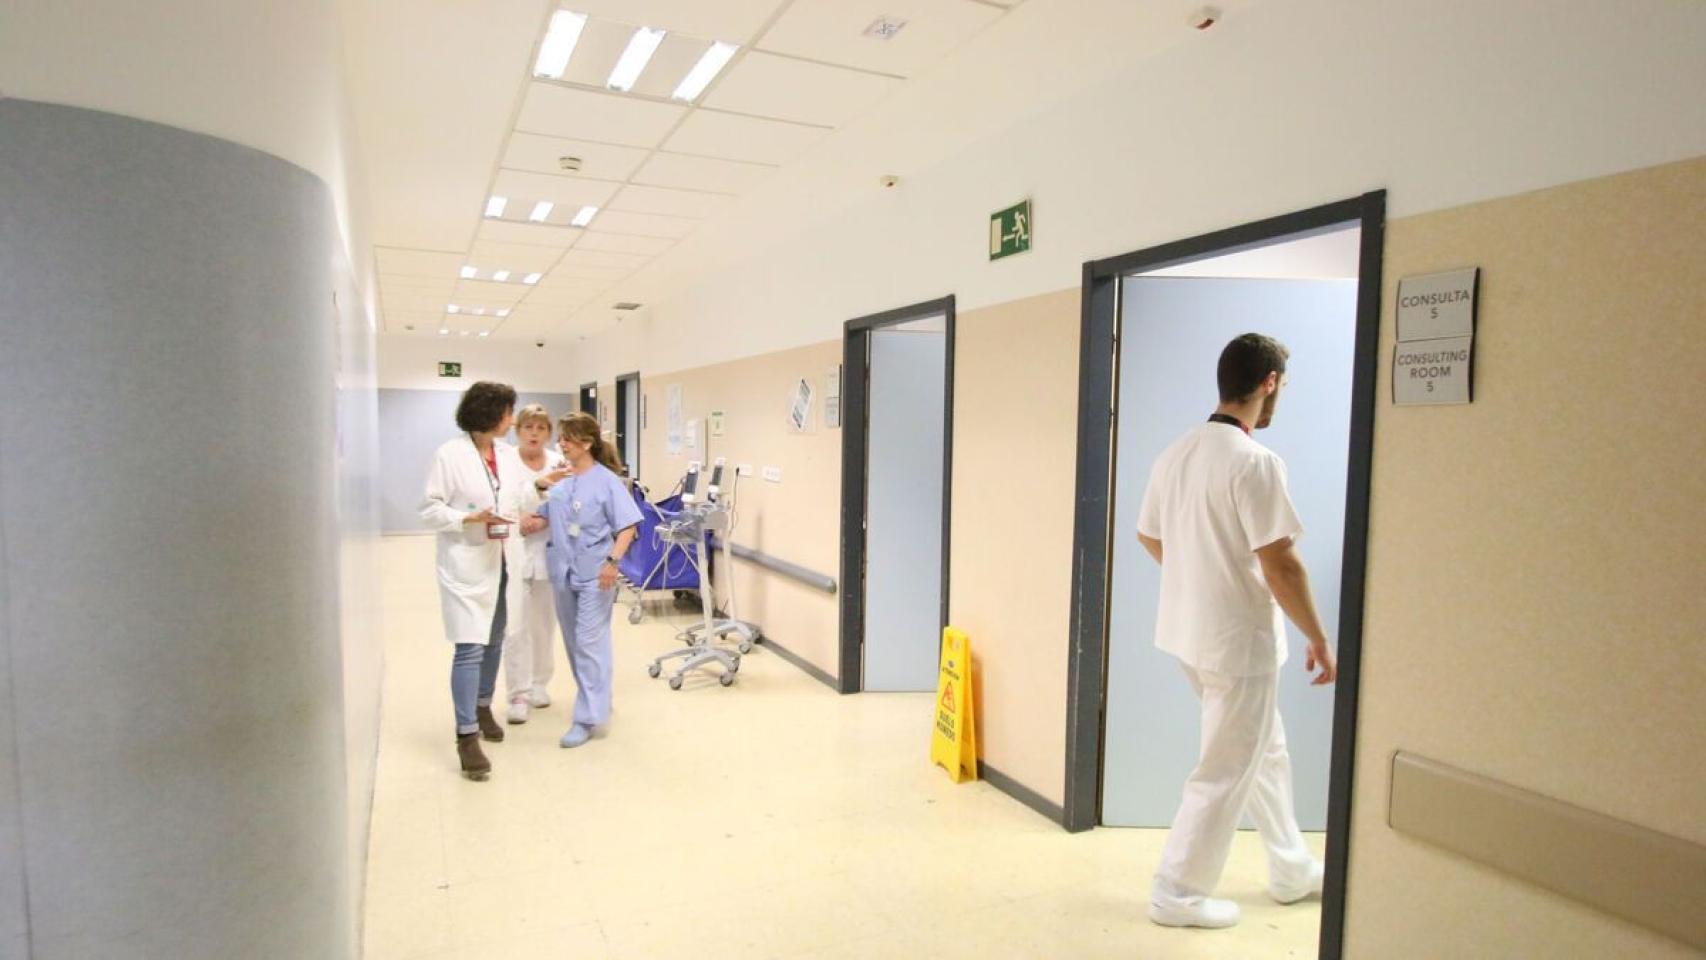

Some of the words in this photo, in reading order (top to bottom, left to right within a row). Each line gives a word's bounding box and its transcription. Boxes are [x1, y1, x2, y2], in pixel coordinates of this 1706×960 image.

[1401, 290, 1470, 308] CONSULTA
[1431, 307, 1439, 319] 5
[1398, 350, 1467, 366] CONSULTING
[1410, 366, 1451, 379] ROOM
[1426, 381, 1434, 392] 5
